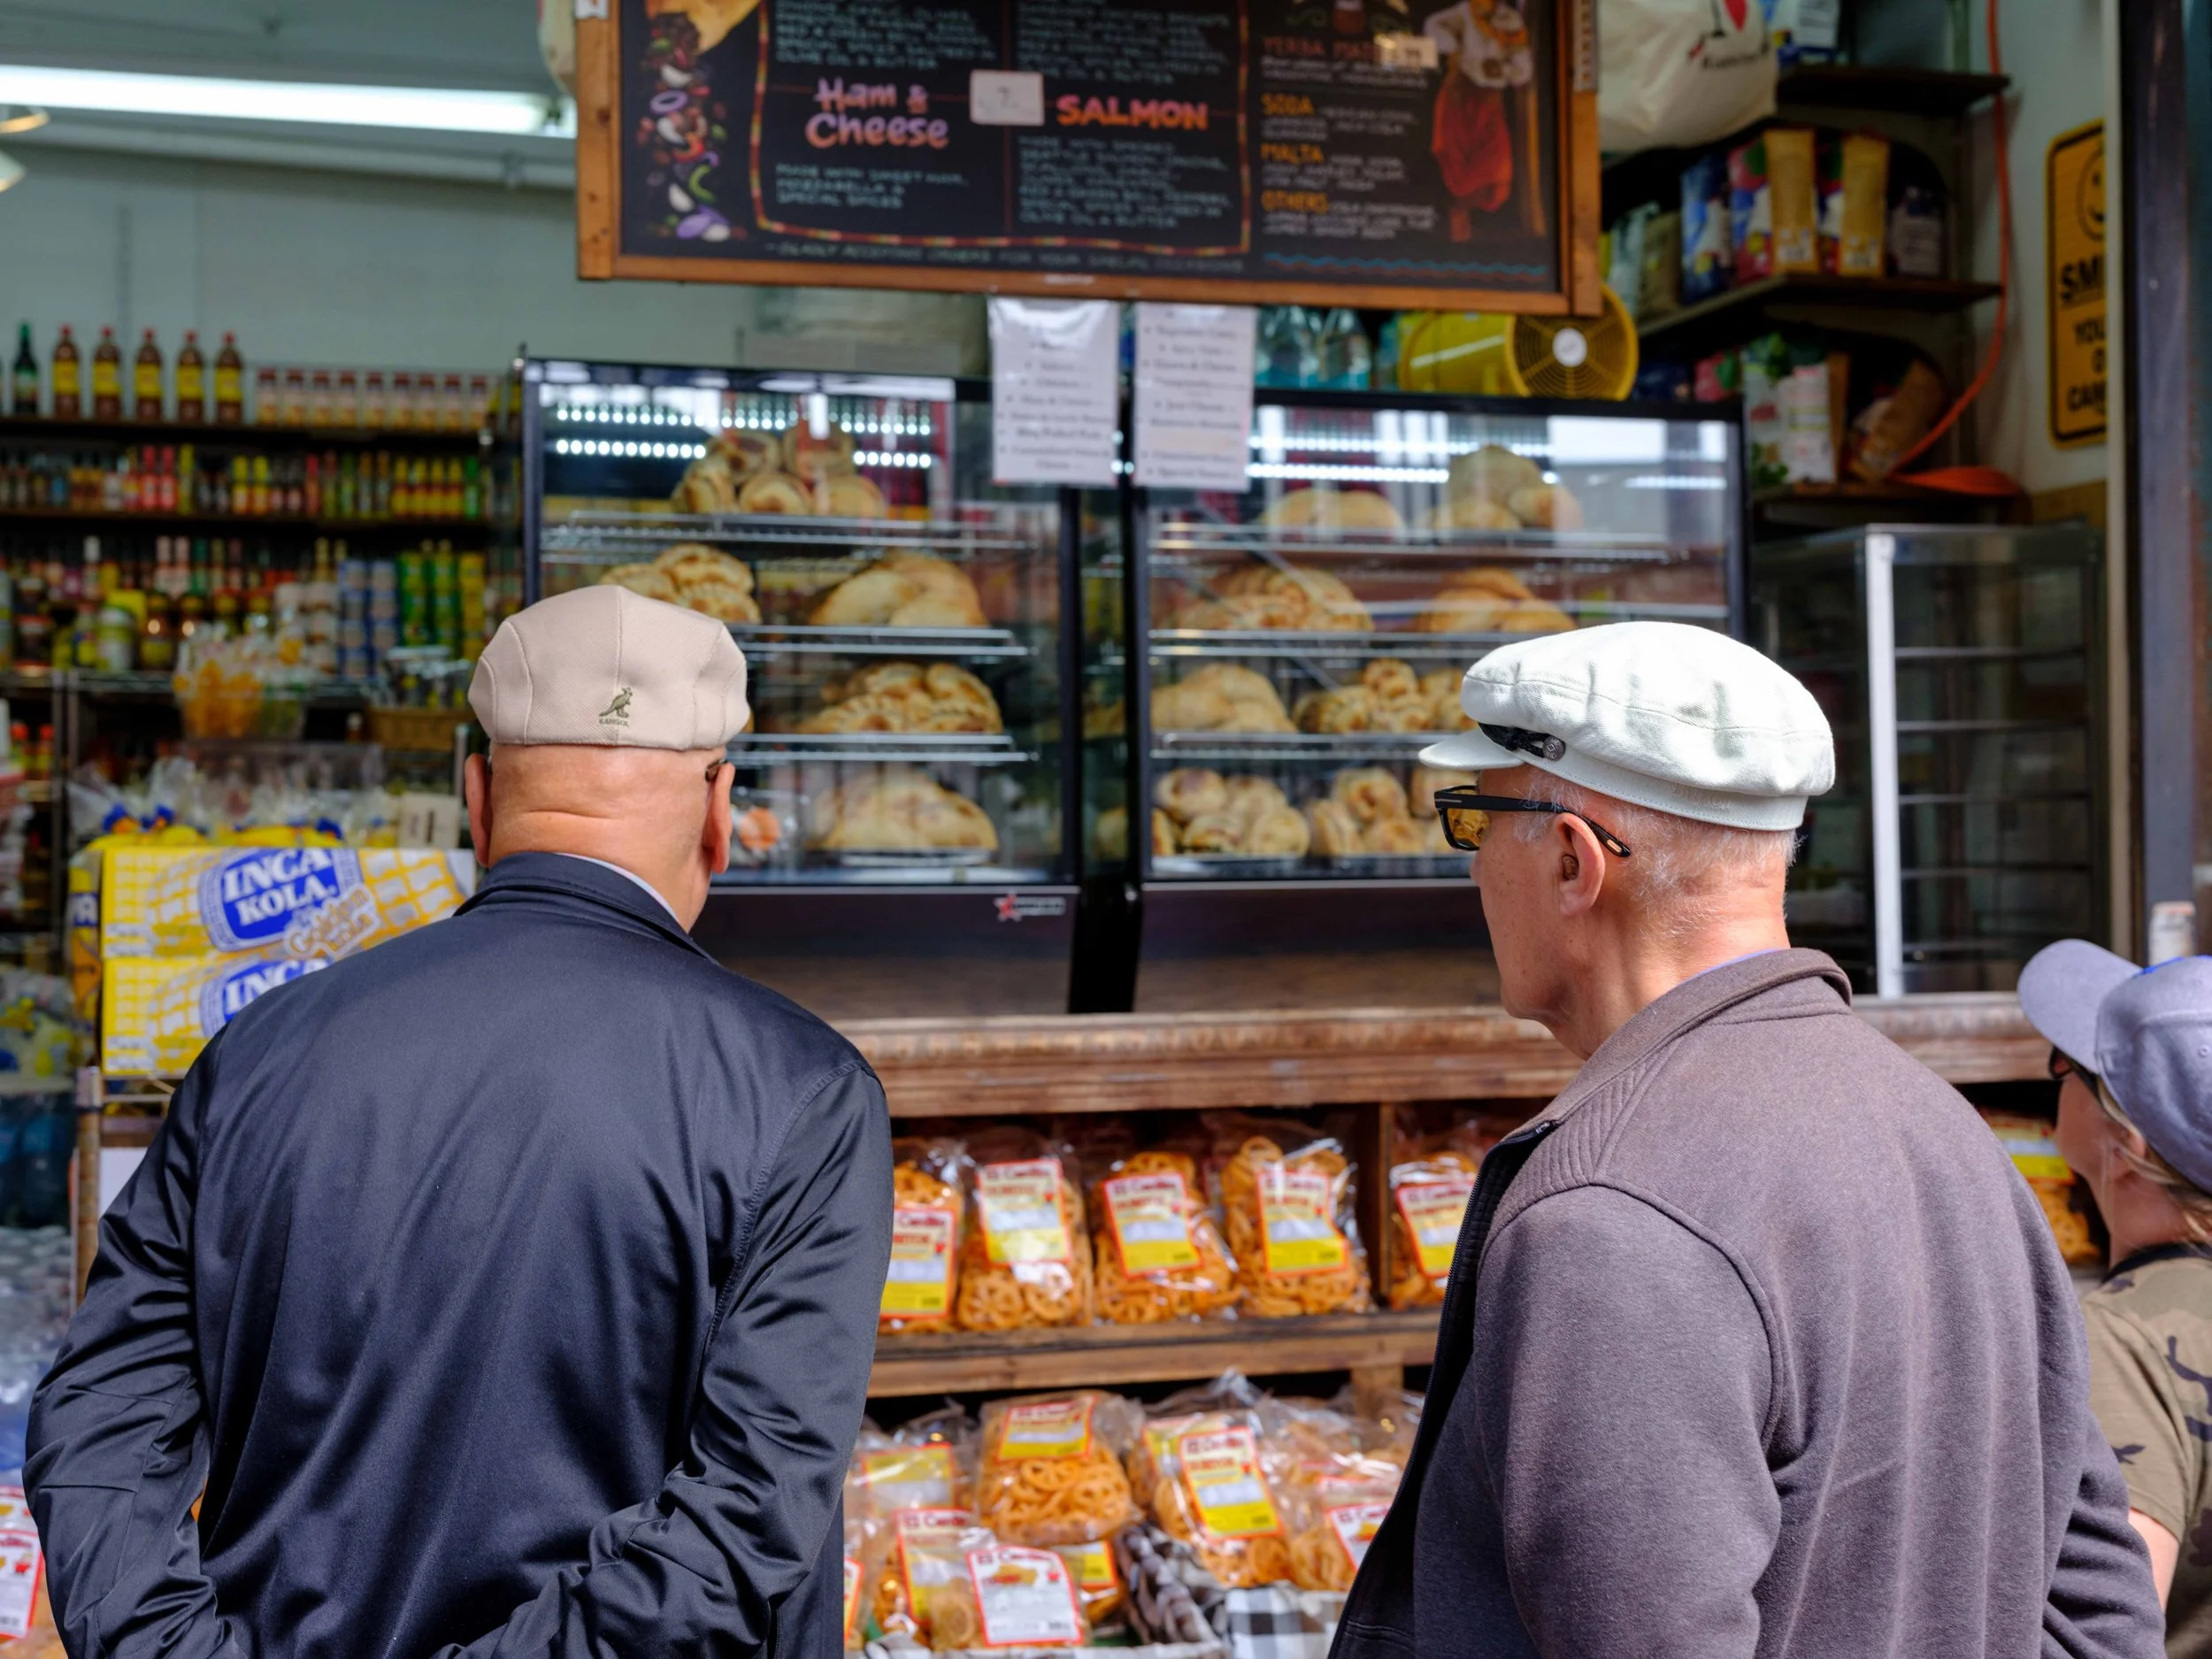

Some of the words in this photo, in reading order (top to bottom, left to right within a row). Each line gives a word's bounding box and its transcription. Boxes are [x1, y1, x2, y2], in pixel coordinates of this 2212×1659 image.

[814, 77, 898, 111] Ham
[906, 84, 929, 114] &
[1056, 94, 1210, 131] SALMON
[1260, 92, 1316, 116] SODA
[805, 111, 949, 149] Cheese
[1260, 142, 1326, 165] MALTA
[776, 190, 842, 207] SPECIAL
[846, 194, 904, 210] SPICES
[1260, 188, 1330, 215] OTHERS
[2061, 253, 2105, 303] SM
[2073, 316, 2106, 346] YOU
[224, 849, 333, 902] INCA
[235, 873, 329, 927] KOLA
